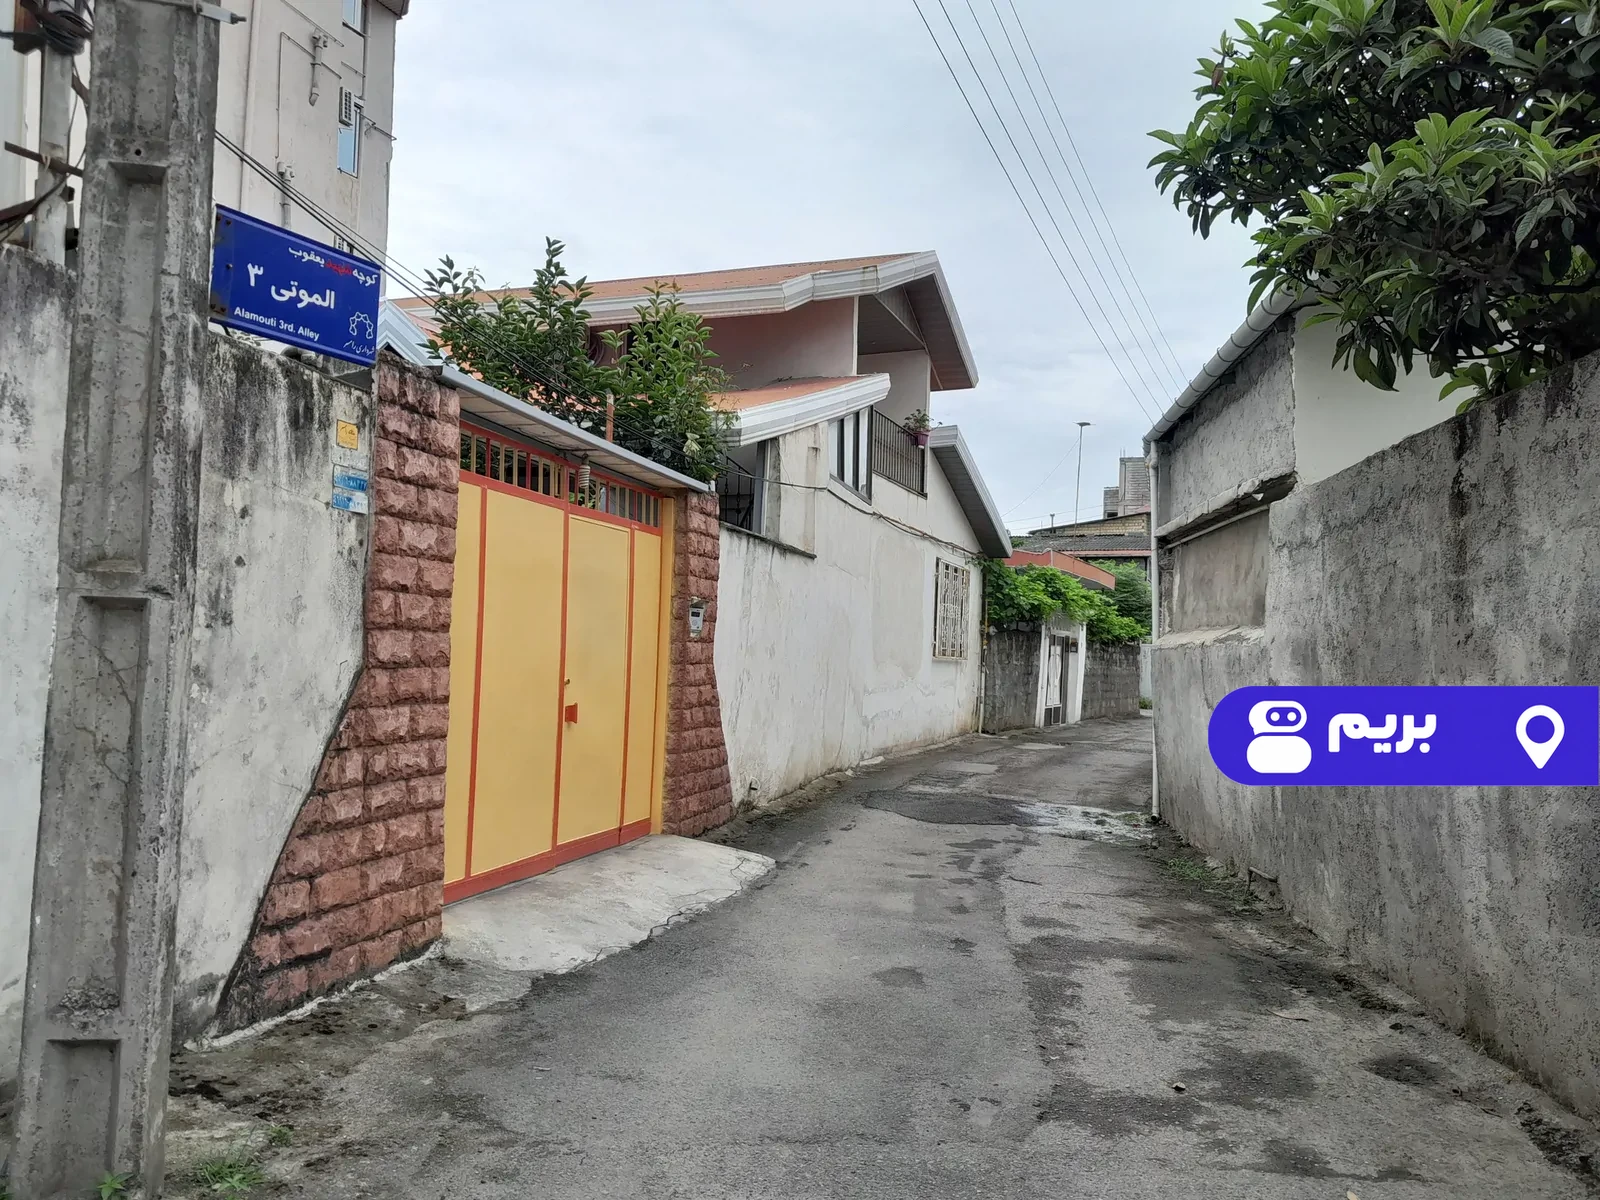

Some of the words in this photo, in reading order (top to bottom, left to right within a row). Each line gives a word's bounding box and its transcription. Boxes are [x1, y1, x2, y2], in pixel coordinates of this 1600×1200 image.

[288, 247, 324, 267] یعقوب
[247, 263, 264, 287] ۳
[353, 269, 378, 286] کوچه
[270, 281, 335, 309] الموتی
[234, 306, 277, 327] Alamouti
[278, 320, 296, 333] 3rd.
[297, 326, 320, 342] Alley
